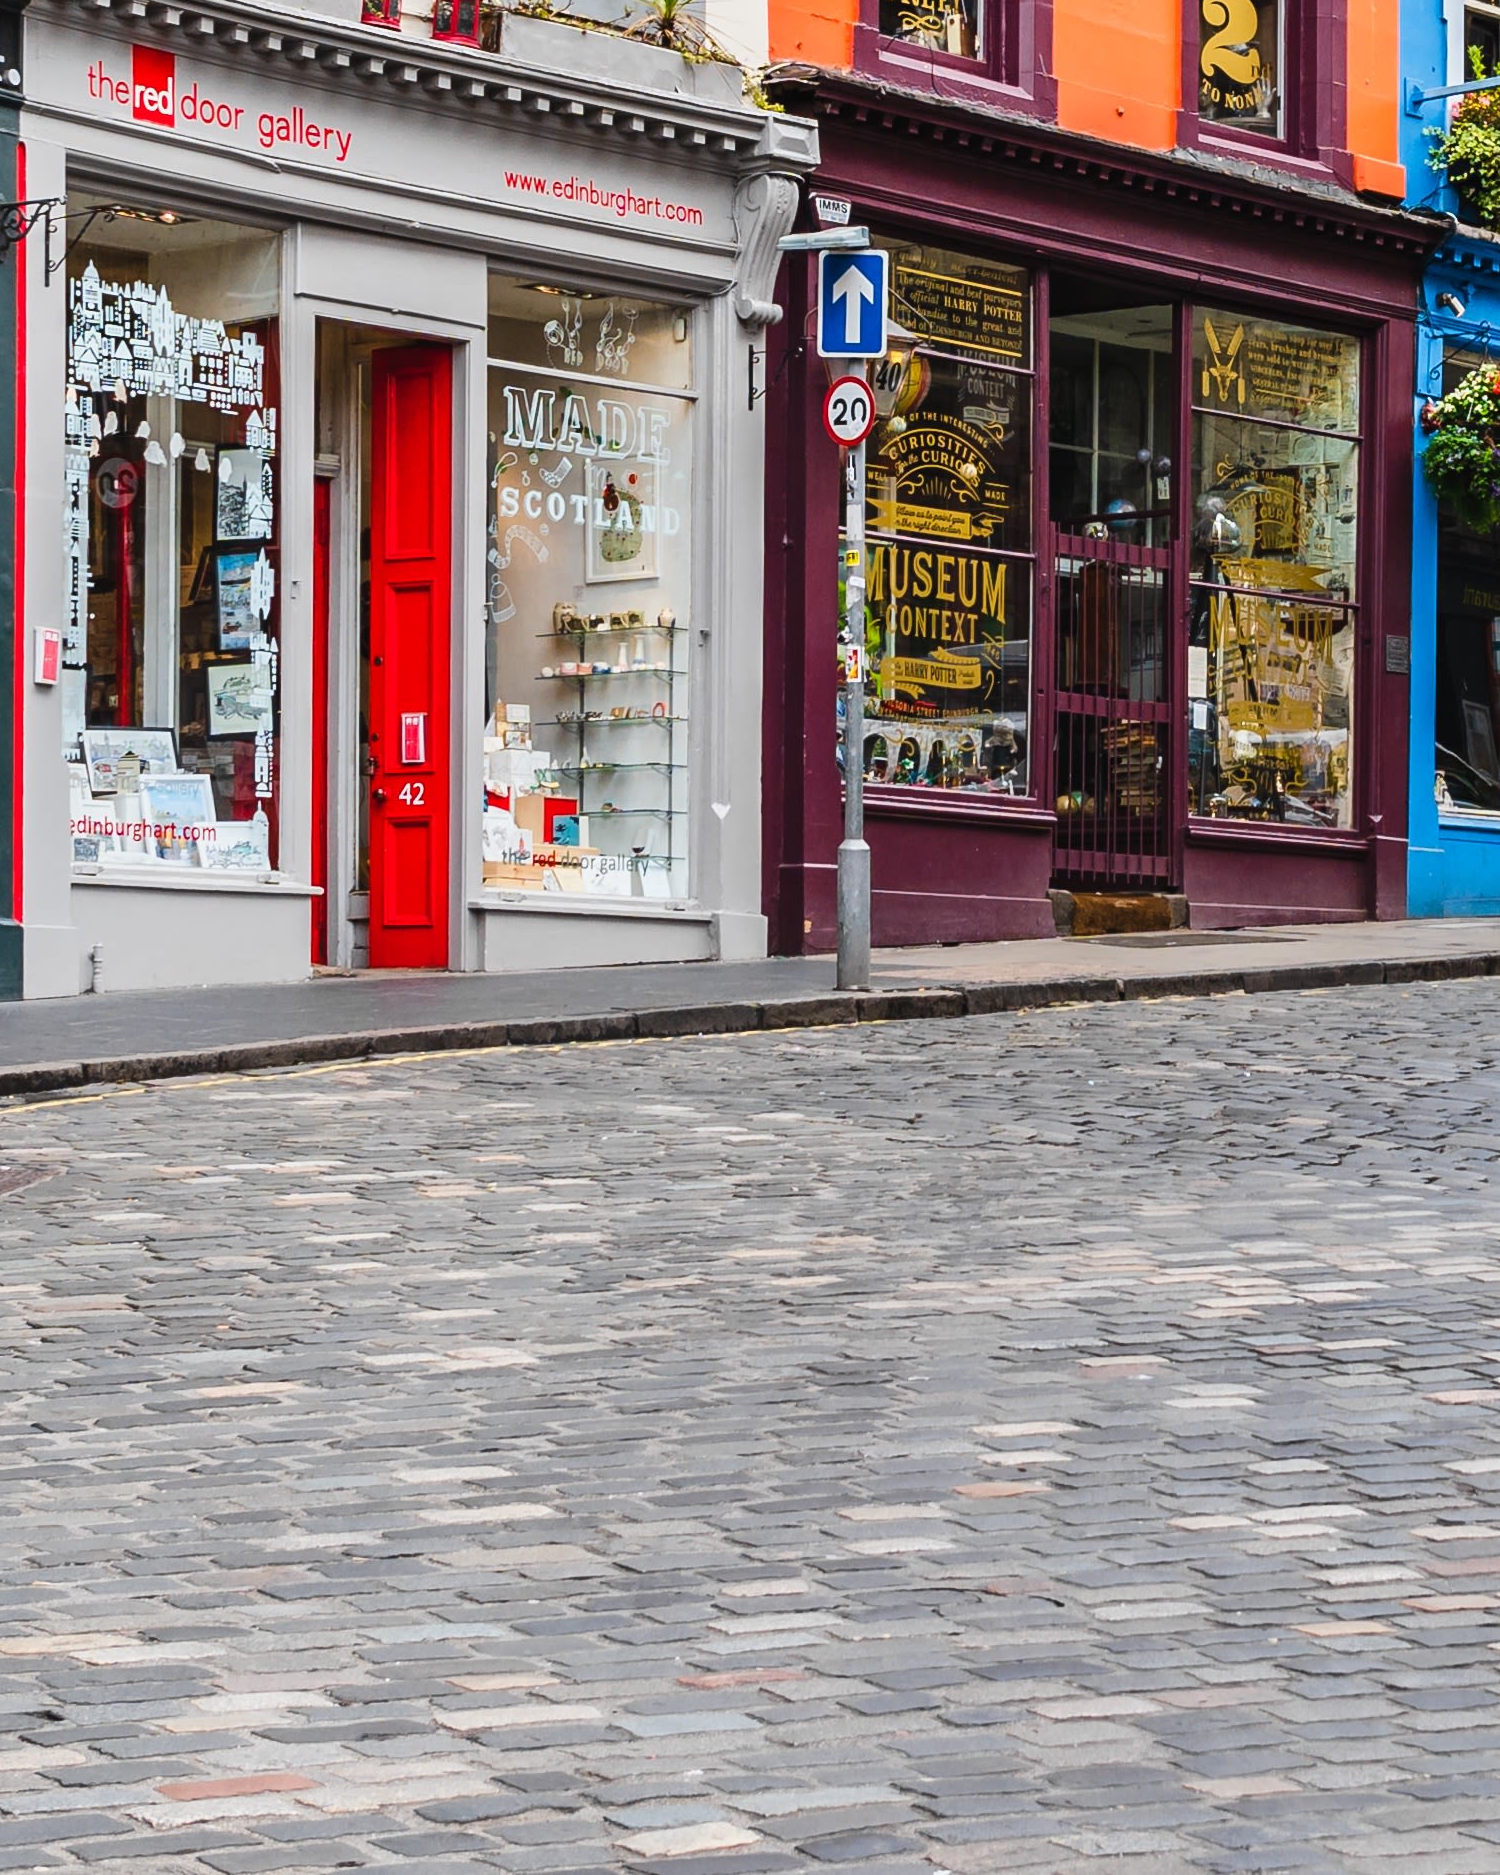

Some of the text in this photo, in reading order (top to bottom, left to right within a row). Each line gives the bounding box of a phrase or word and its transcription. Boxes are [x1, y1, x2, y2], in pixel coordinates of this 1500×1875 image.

[1201, 77, 1220, 103] TO
[88, 60, 353, 163] the red door gallery
[505, 170, 704, 227] www.edinburghart.com
[898, 272, 916, 285] The
[916, 277, 949, 293] original
[951, 284, 965, 297] and
[984, 293, 1023, 310] purveyors
[944, 297, 979, 314] HARRY
[983, 304, 1023, 323] POTTER
[982, 321, 1004, 335] great
[875, 359, 902, 393] 40
[503, 385, 671, 467] MADE
[832, 397, 867, 426] 20
[909, 412, 920, 422] OF
[923, 411, 937, 422] THE
[940, 414, 989, 450] INTERESTING
[888, 433, 986, 475] CURIOSITIES
[921, 450, 981, 488] CURIOS
[500, 486, 681, 536] SCOTLAND
[984, 489, 1006, 502] MADE
[865, 545, 1007, 625] MUSEUM
[885, 603, 979, 644] CONTEXT
[1209, 594, 1334, 670] MUSEUM
[904, 663, 928, 680] HARRY
[930, 666, 958, 686] POTTER
[916, 704, 940, 718] STREET
[398, 782, 425, 806] 42
[502, 848, 650, 877] the red door gallery
